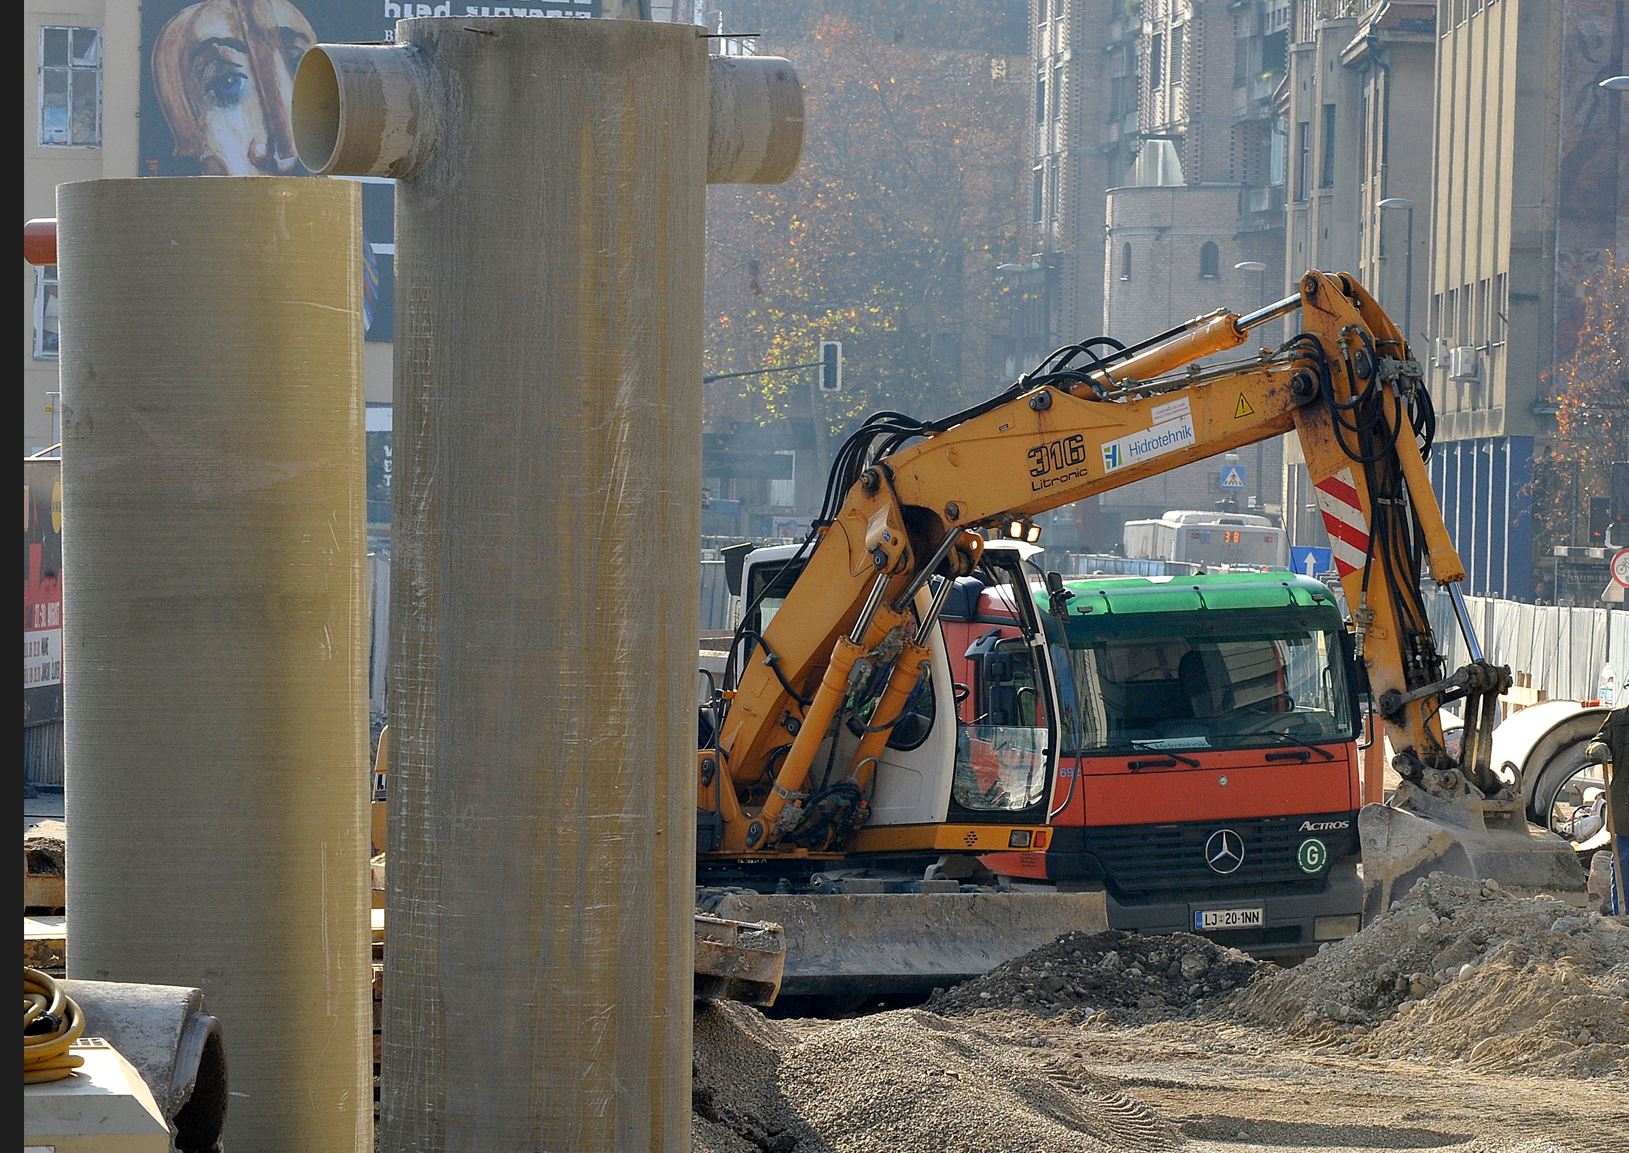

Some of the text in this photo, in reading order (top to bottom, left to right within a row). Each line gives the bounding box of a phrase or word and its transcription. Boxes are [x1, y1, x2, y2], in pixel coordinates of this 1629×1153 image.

[1129, 425, 1192, 457] Hidrotehnik
[1028, 434, 1086, 478] 316
[1031, 468, 1088, 491] Litronic
[1306, 845, 1319, 866] G
